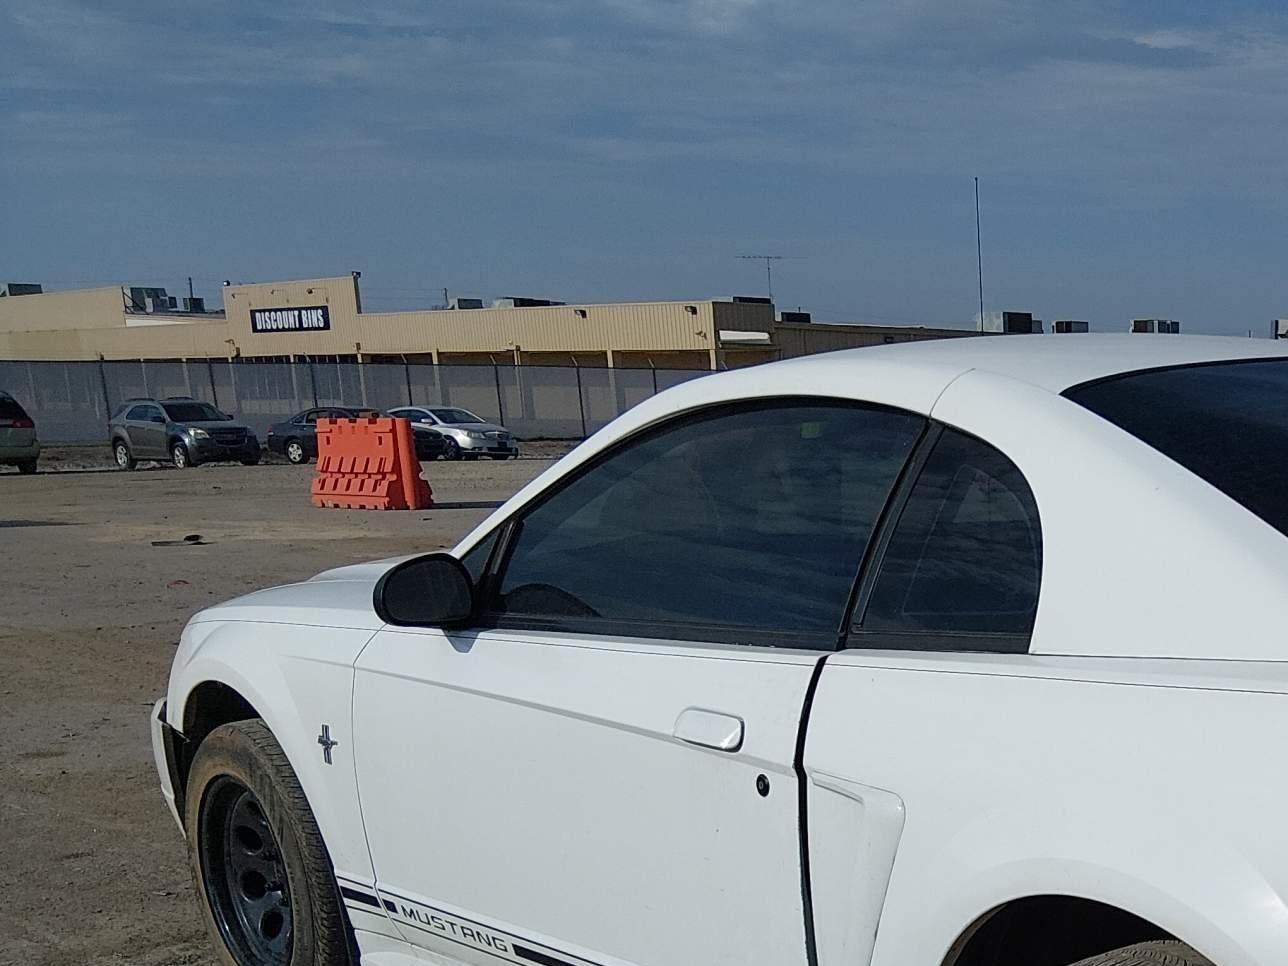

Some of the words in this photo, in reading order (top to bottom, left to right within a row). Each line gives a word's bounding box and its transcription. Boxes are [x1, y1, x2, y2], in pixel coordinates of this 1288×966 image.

[255, 311, 299, 329] DISCOUNT
[301, 310, 324, 327] BINS
[400, 905, 508, 952] MUSTANG
